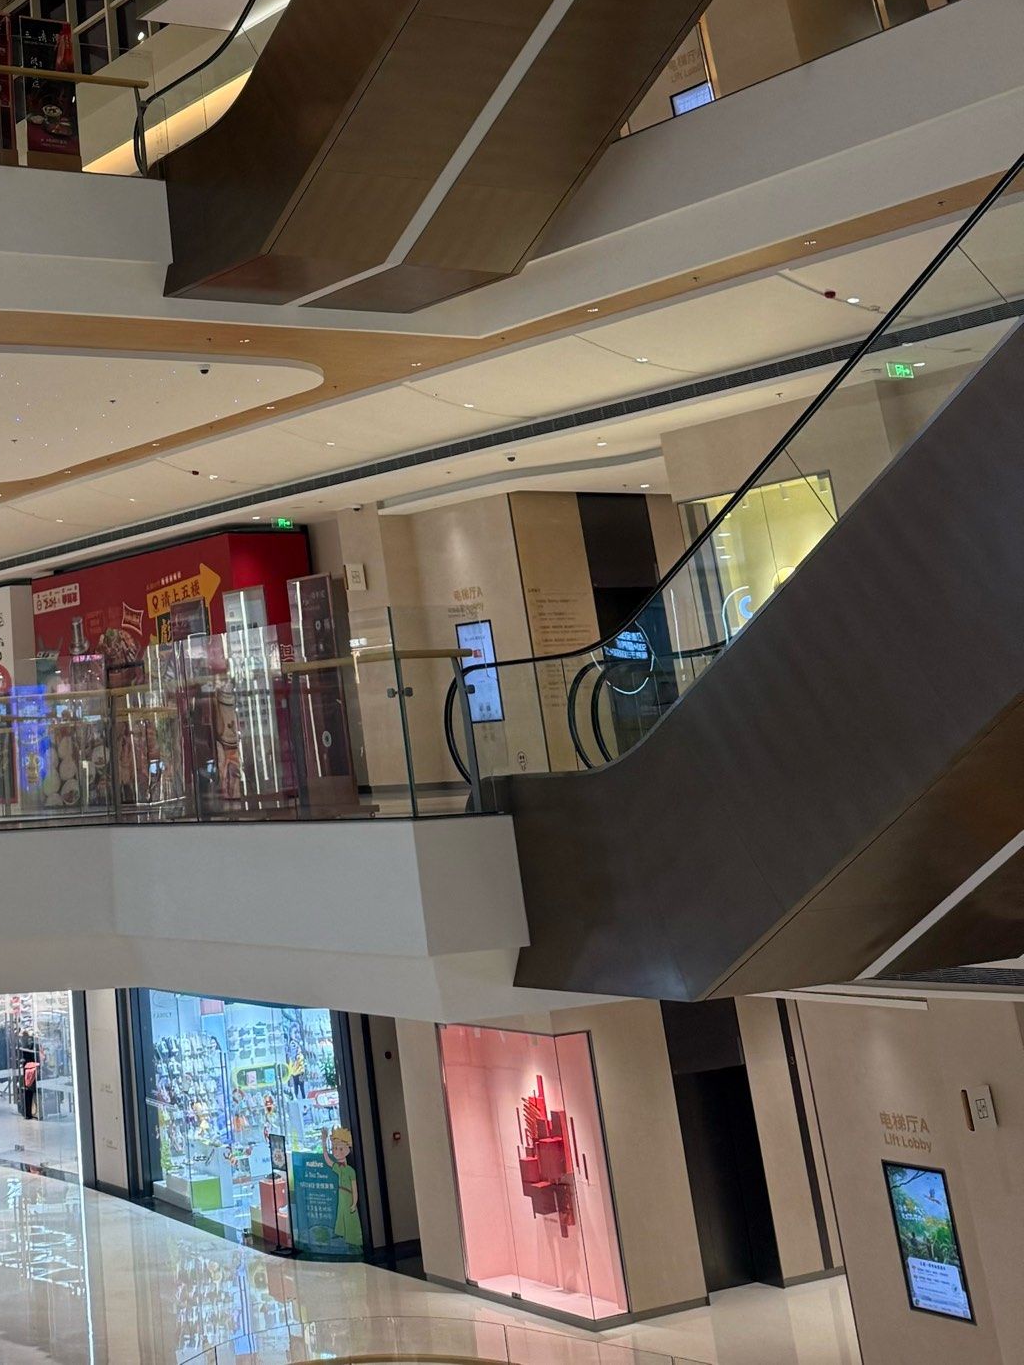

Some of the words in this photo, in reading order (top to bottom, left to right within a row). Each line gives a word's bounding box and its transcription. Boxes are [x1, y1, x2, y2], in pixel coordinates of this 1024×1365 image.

[879, 1111, 930, 1134] 电梯厅A
[884, 1133, 901, 1146] Lift
[902, 1135, 932, 1153] Lobby
